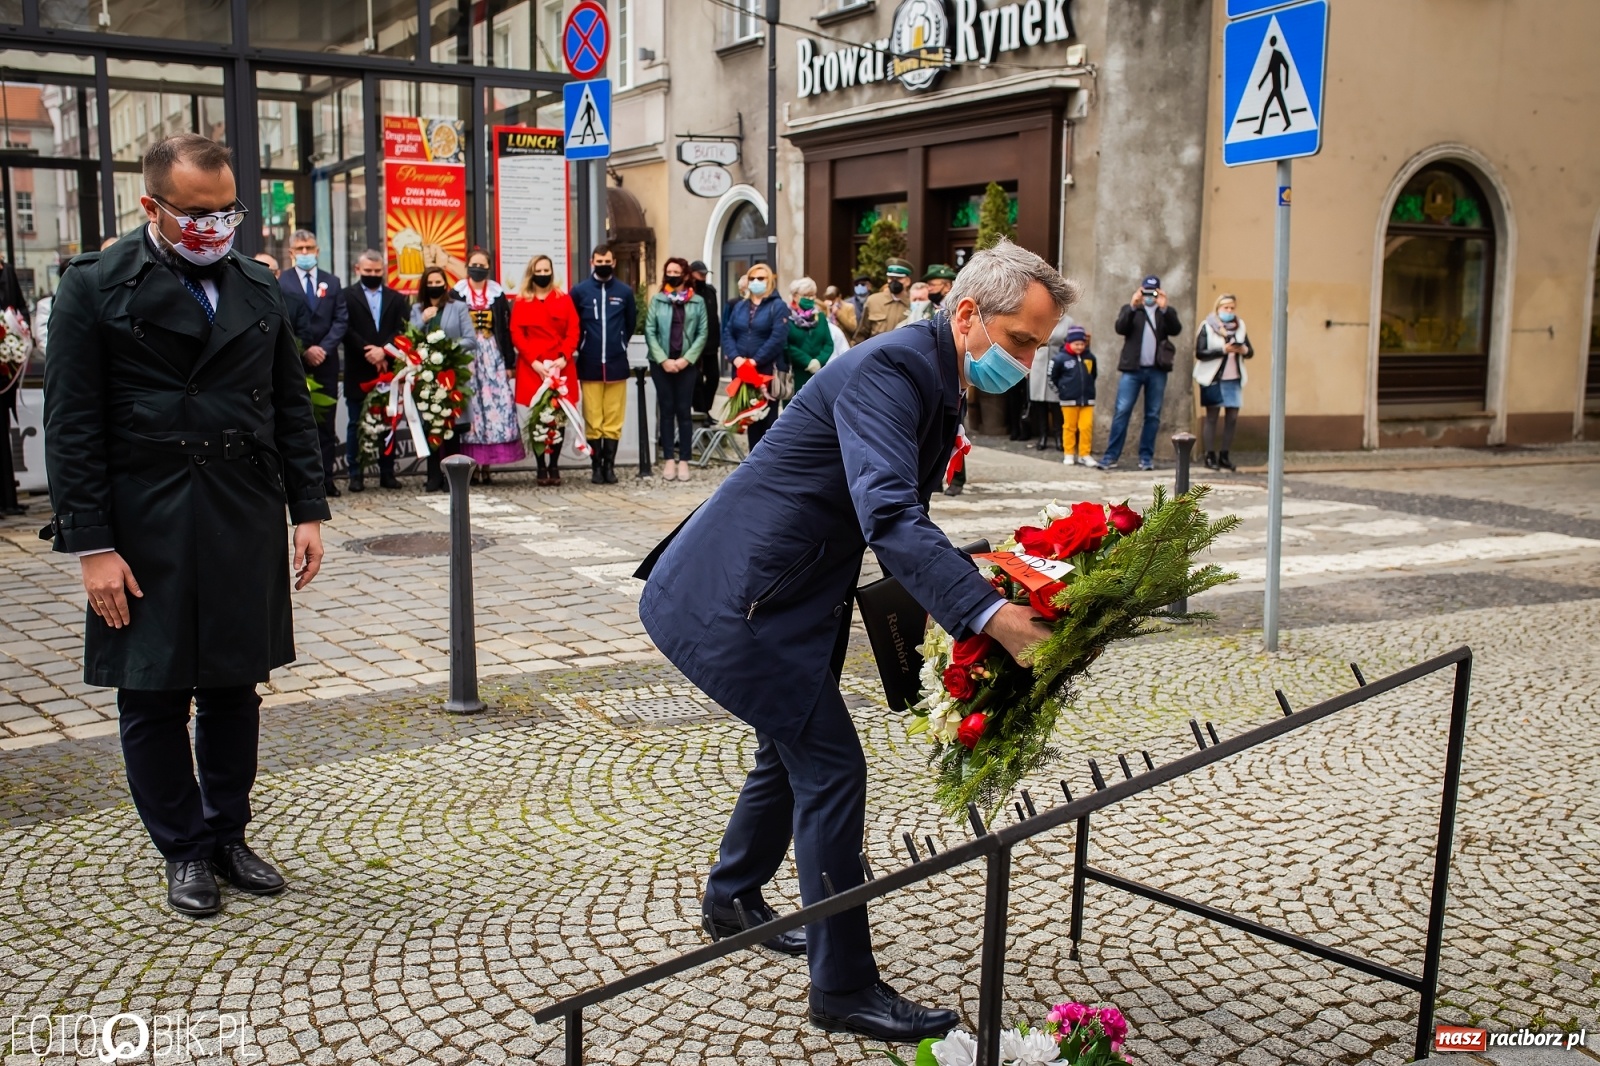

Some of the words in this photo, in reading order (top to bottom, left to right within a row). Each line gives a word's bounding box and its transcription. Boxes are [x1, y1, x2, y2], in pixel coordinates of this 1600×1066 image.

[797, 38, 890, 98] Browar
[955, 0, 1070, 69] Rynek
[385, 130, 405, 143] Druga
[507, 133, 557, 149] LUNCH
[396, 165, 456, 188] Promocja
[405, 187, 424, 196] DWA
[425, 188, 446, 197] PIWA
[391, 197, 400, 205] W
[401, 197, 424, 206] CENIE
[425, 197, 460, 208] JEDNEGO
[886, 611, 910, 674] Racibórz
